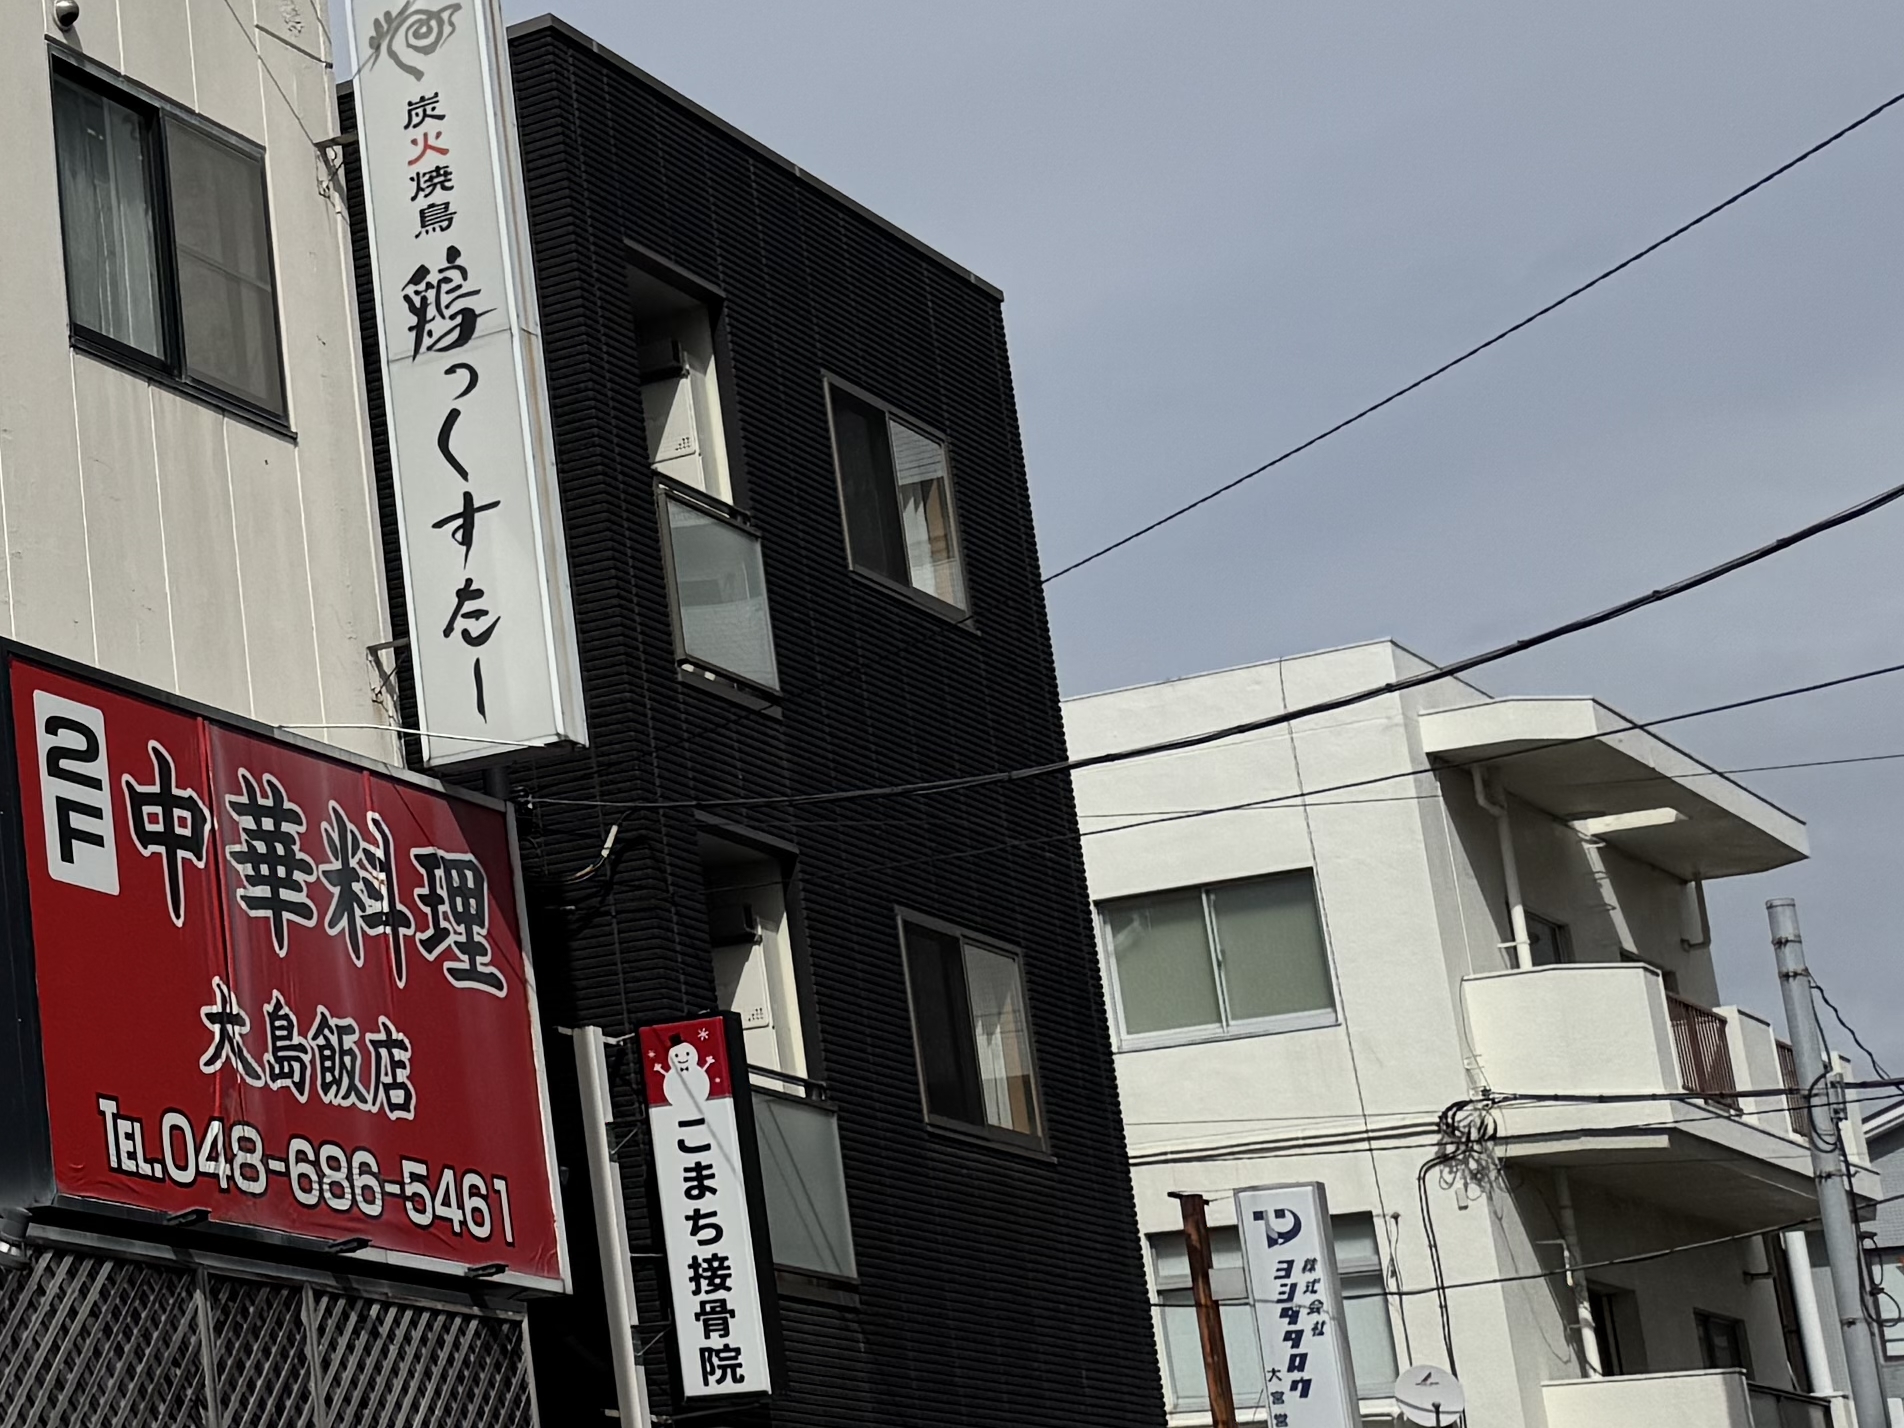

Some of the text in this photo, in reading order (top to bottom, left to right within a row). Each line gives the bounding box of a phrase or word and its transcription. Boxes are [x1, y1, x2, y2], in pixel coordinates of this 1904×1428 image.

[403, 92, 457, 239] 炭火焼鳥
[44, 714, 105, 865] 2F
[122, 740, 507, 999] 中華料理
[199, 975, 416, 1121] 大島飯店
[677, 1117, 745, 1387] こまち接骨院
[1301, 1257, 1326, 1337] 株式会社
